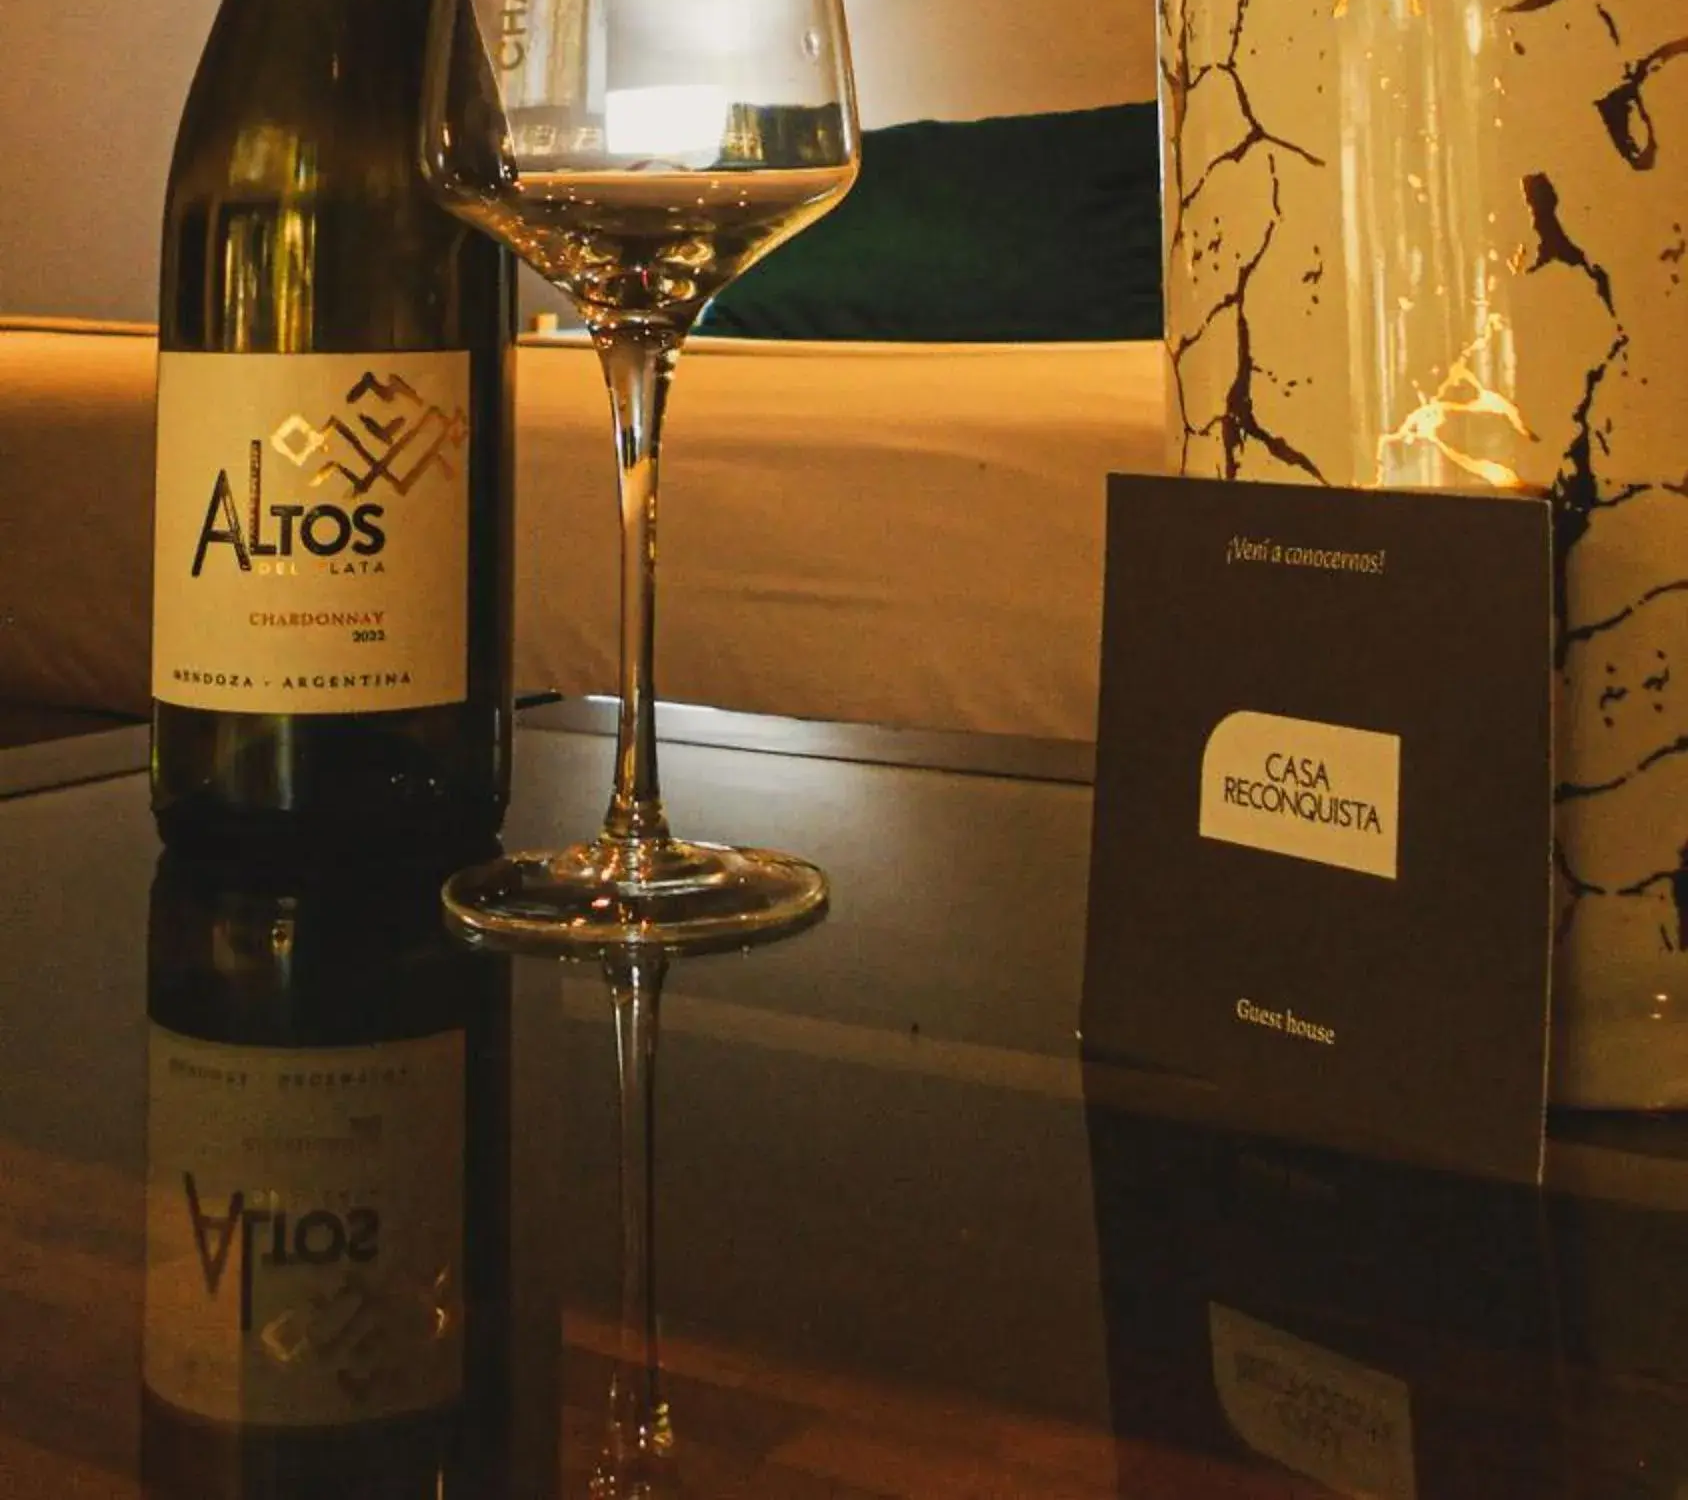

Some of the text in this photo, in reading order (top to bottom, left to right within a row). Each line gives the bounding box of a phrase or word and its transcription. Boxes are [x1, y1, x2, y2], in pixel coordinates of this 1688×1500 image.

[258, 562, 299, 575] DEL
[1272, 546, 1281, 563] a
[1285, 547, 1386, 574] conocernos!
[250, 611, 386, 626] CHARDONNAY
[173, 669, 253, 689] MENDOZA
[282, 672, 412, 690] ARGENTINA
[1265, 752, 1331, 792] CASA
[1224, 776, 1382, 835] RECONQUISTA
[1237, 998, 1334, 1045] Guest house
